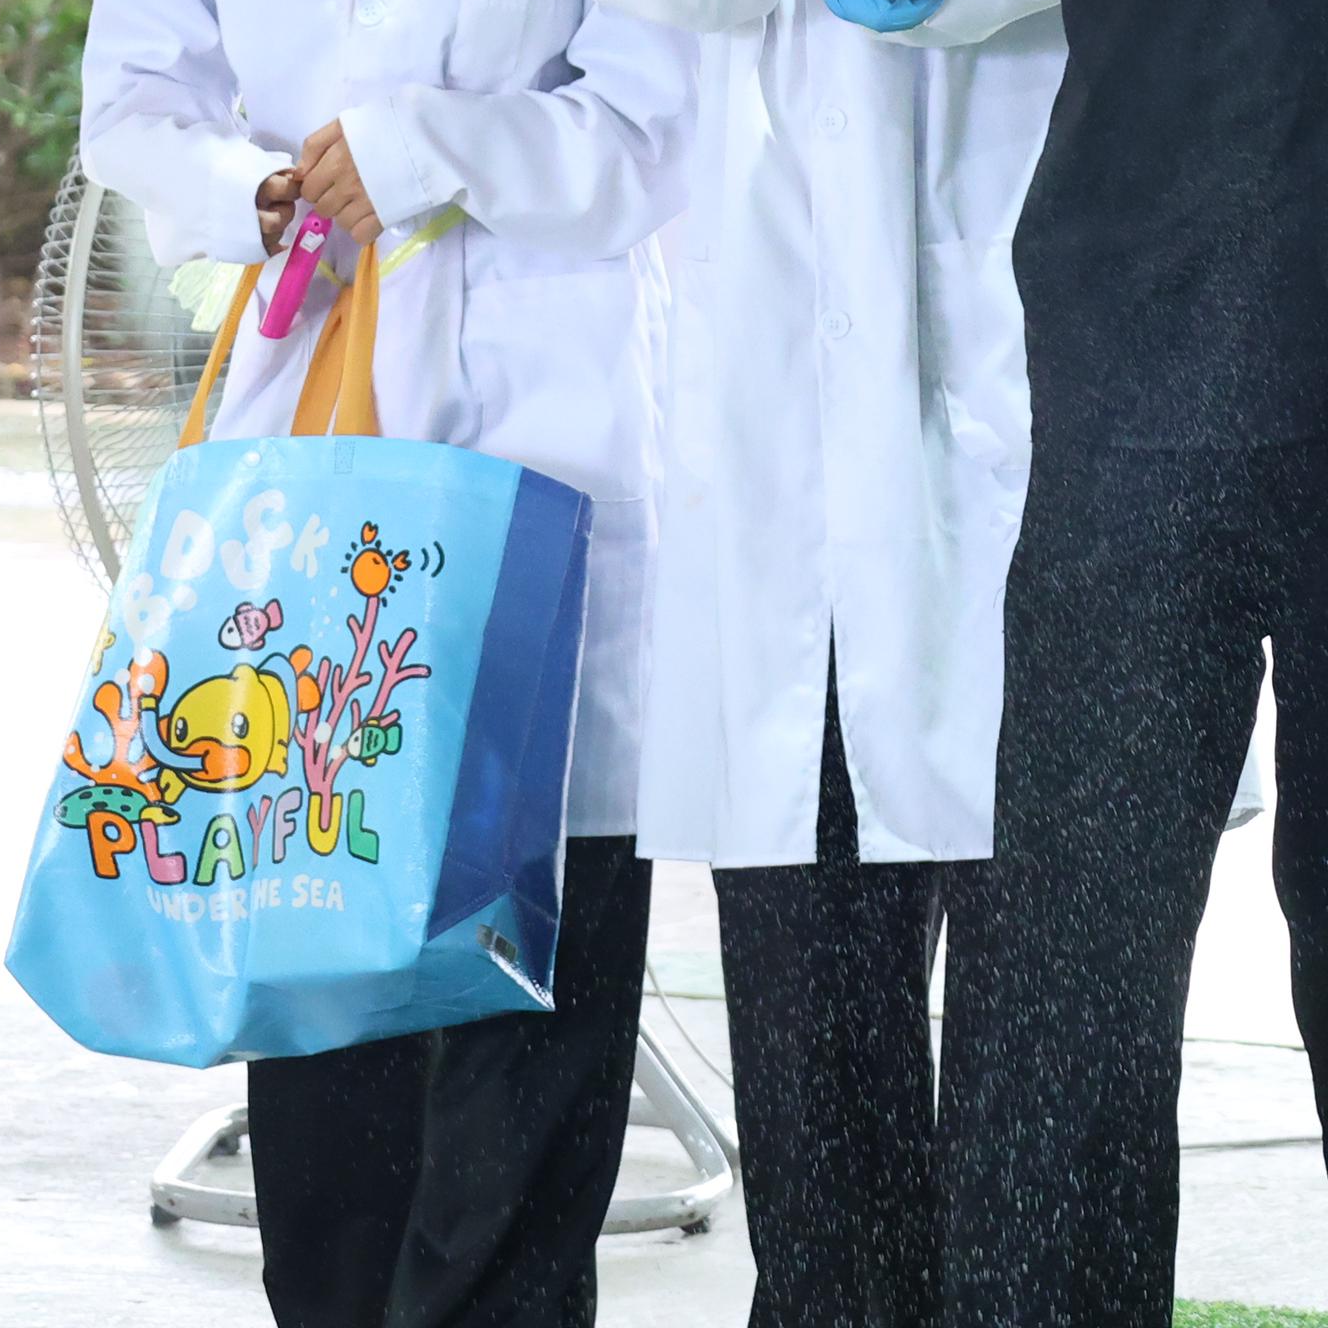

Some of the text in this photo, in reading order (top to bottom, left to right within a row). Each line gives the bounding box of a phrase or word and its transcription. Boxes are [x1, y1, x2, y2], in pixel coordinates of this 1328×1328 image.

[85, 786, 380, 886] PLAYFUL
[146, 885, 249, 922] UNDER
[291, 873, 345, 912] SEA
